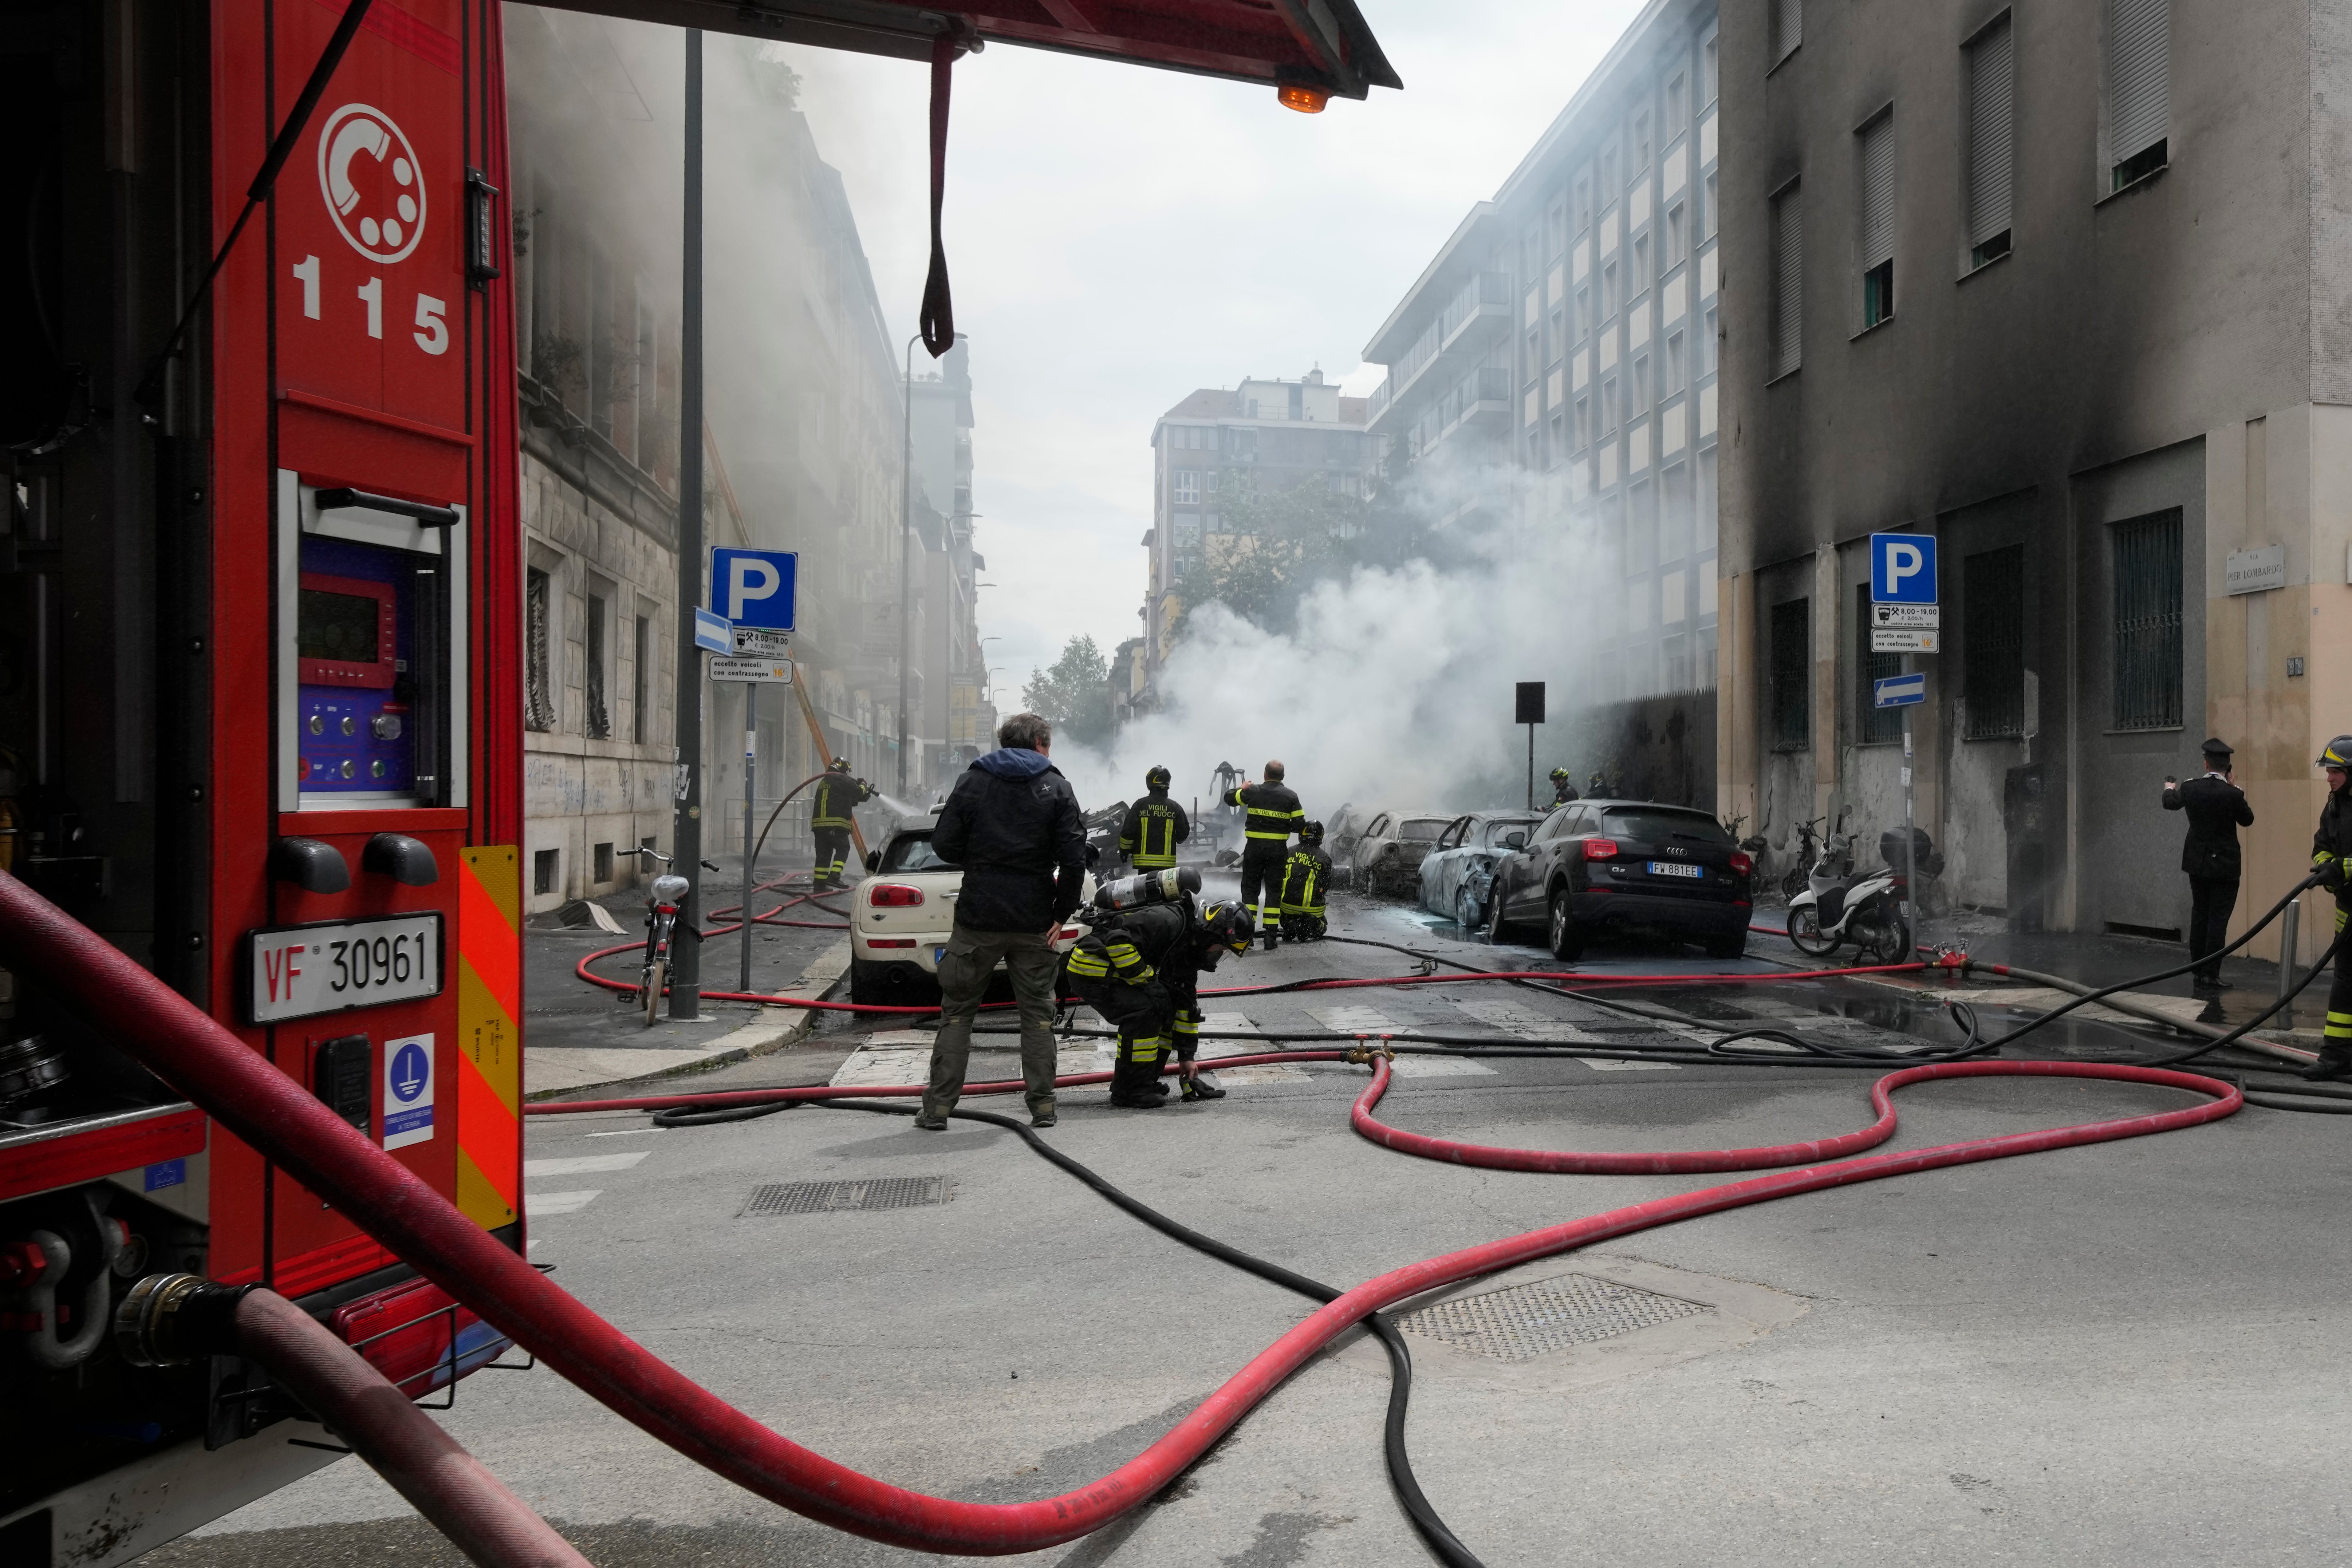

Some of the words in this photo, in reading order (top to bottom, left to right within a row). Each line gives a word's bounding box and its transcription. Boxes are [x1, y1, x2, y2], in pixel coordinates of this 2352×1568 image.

[1886, 543, 1922, 594] P
[2228, 571, 2241, 582] PIER
[2243, 564, 2282, 579] LOMBARDO
[728, 557, 780, 620] P
[1923, 639, 1930, 647] 16
[774, 668, 783, 677] 16
[1295, 852, 1315, 861] VIGII
[1654, 864, 1665, 874] FW
[1669, 865, 1697, 876] 881EE
[264, 945, 305, 1003] VF
[330, 932, 425, 992] 30961
